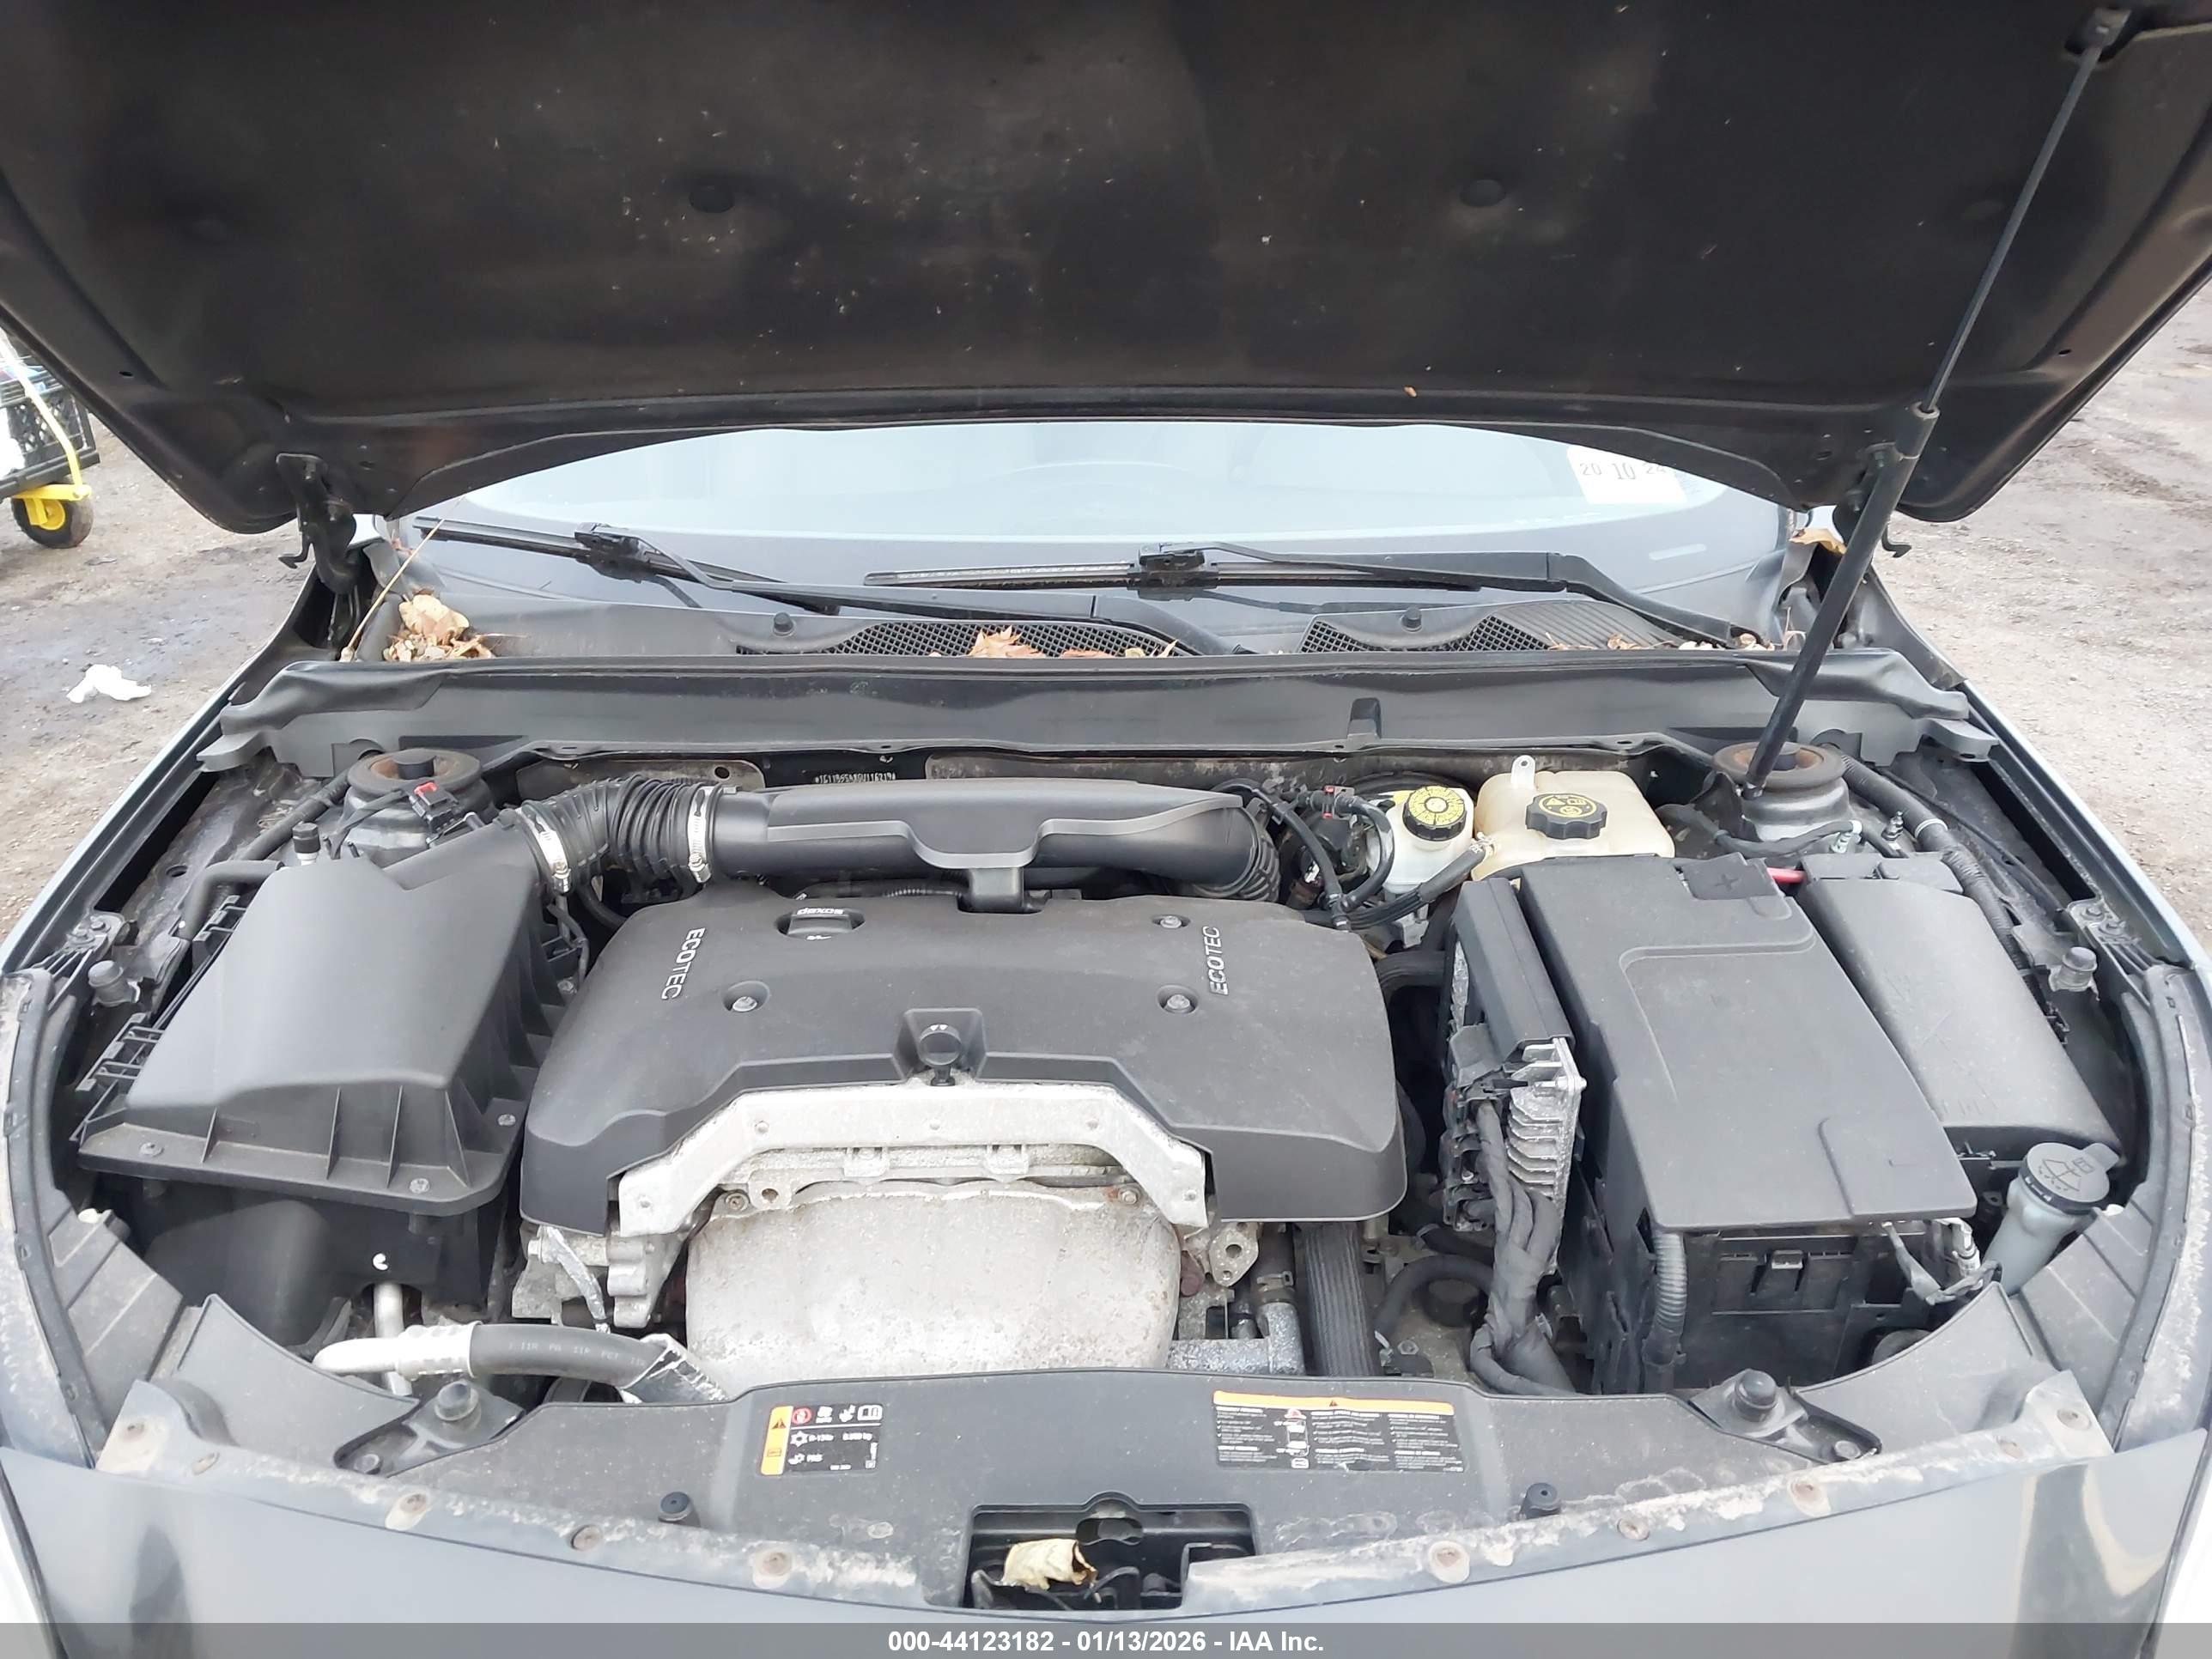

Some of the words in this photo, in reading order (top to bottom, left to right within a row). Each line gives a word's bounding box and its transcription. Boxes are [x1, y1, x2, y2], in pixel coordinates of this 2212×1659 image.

[1579, 463, 1602, 476] 20
[1612, 462, 1637, 480] 10
[660, 927, 706, 1000] ECOTEC
[1202, 926, 1229, 995] ECOTEC
